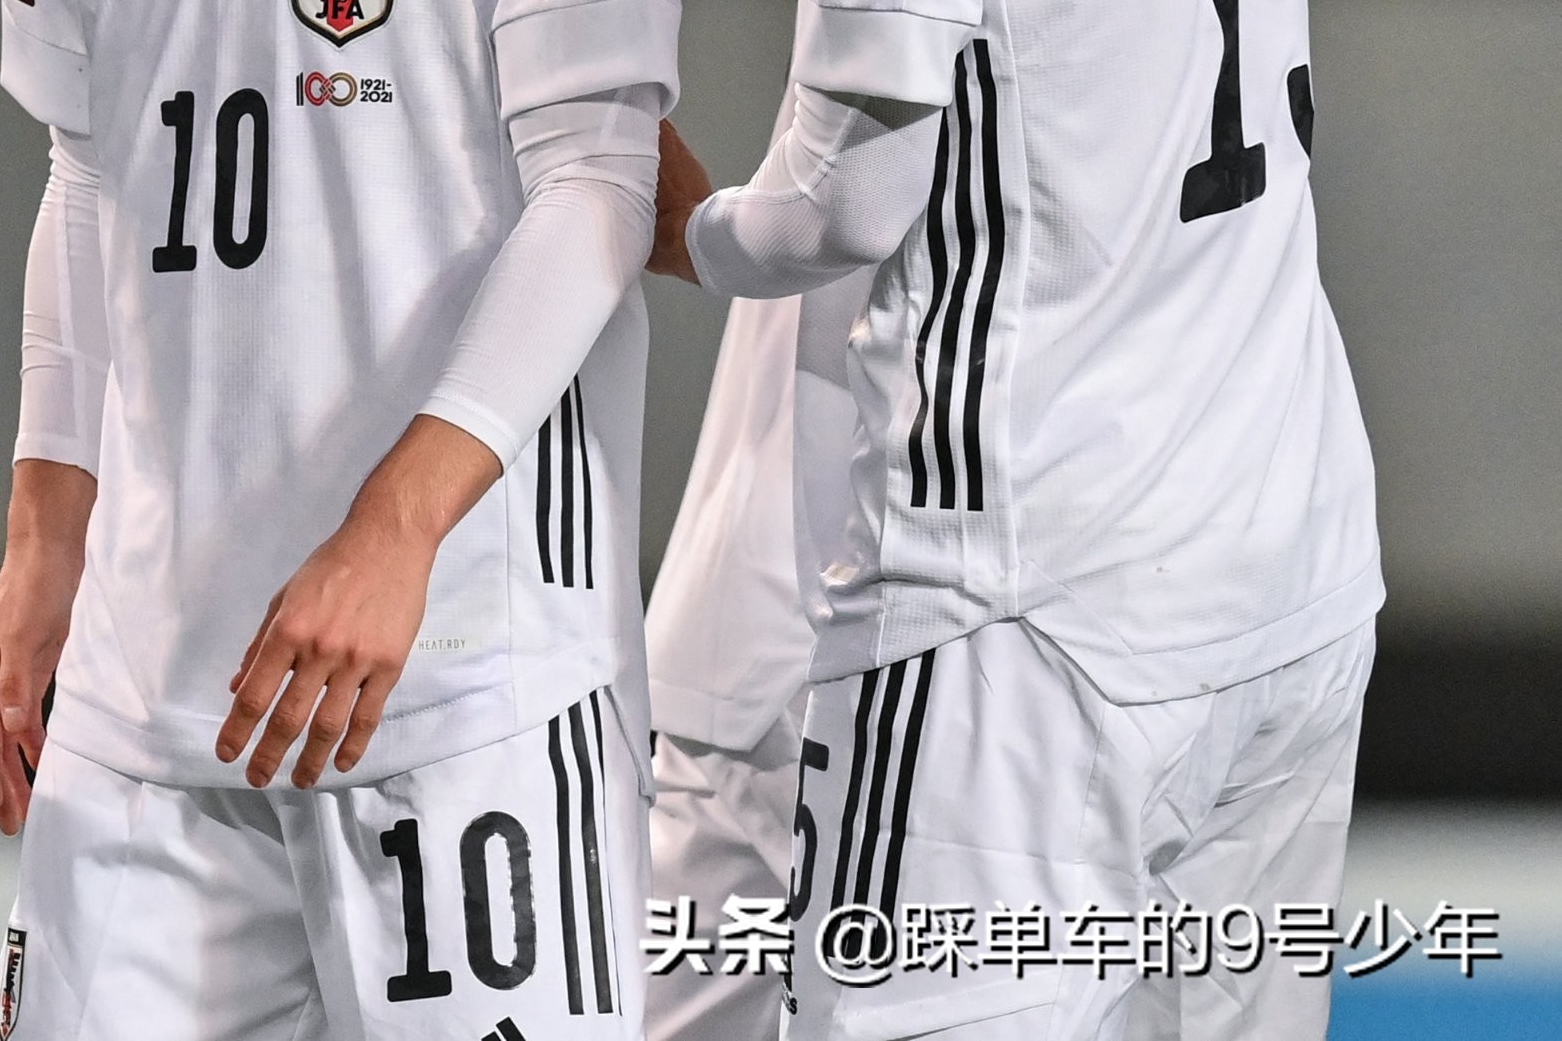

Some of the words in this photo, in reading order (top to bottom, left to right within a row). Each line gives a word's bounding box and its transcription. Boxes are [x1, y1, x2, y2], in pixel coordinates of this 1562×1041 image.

[360, 89, 393, 103] 2021
[152, 87, 269, 273] 10
[418, 639, 466, 651] HEAT.RDY
[380, 810, 537, 1003] 10
